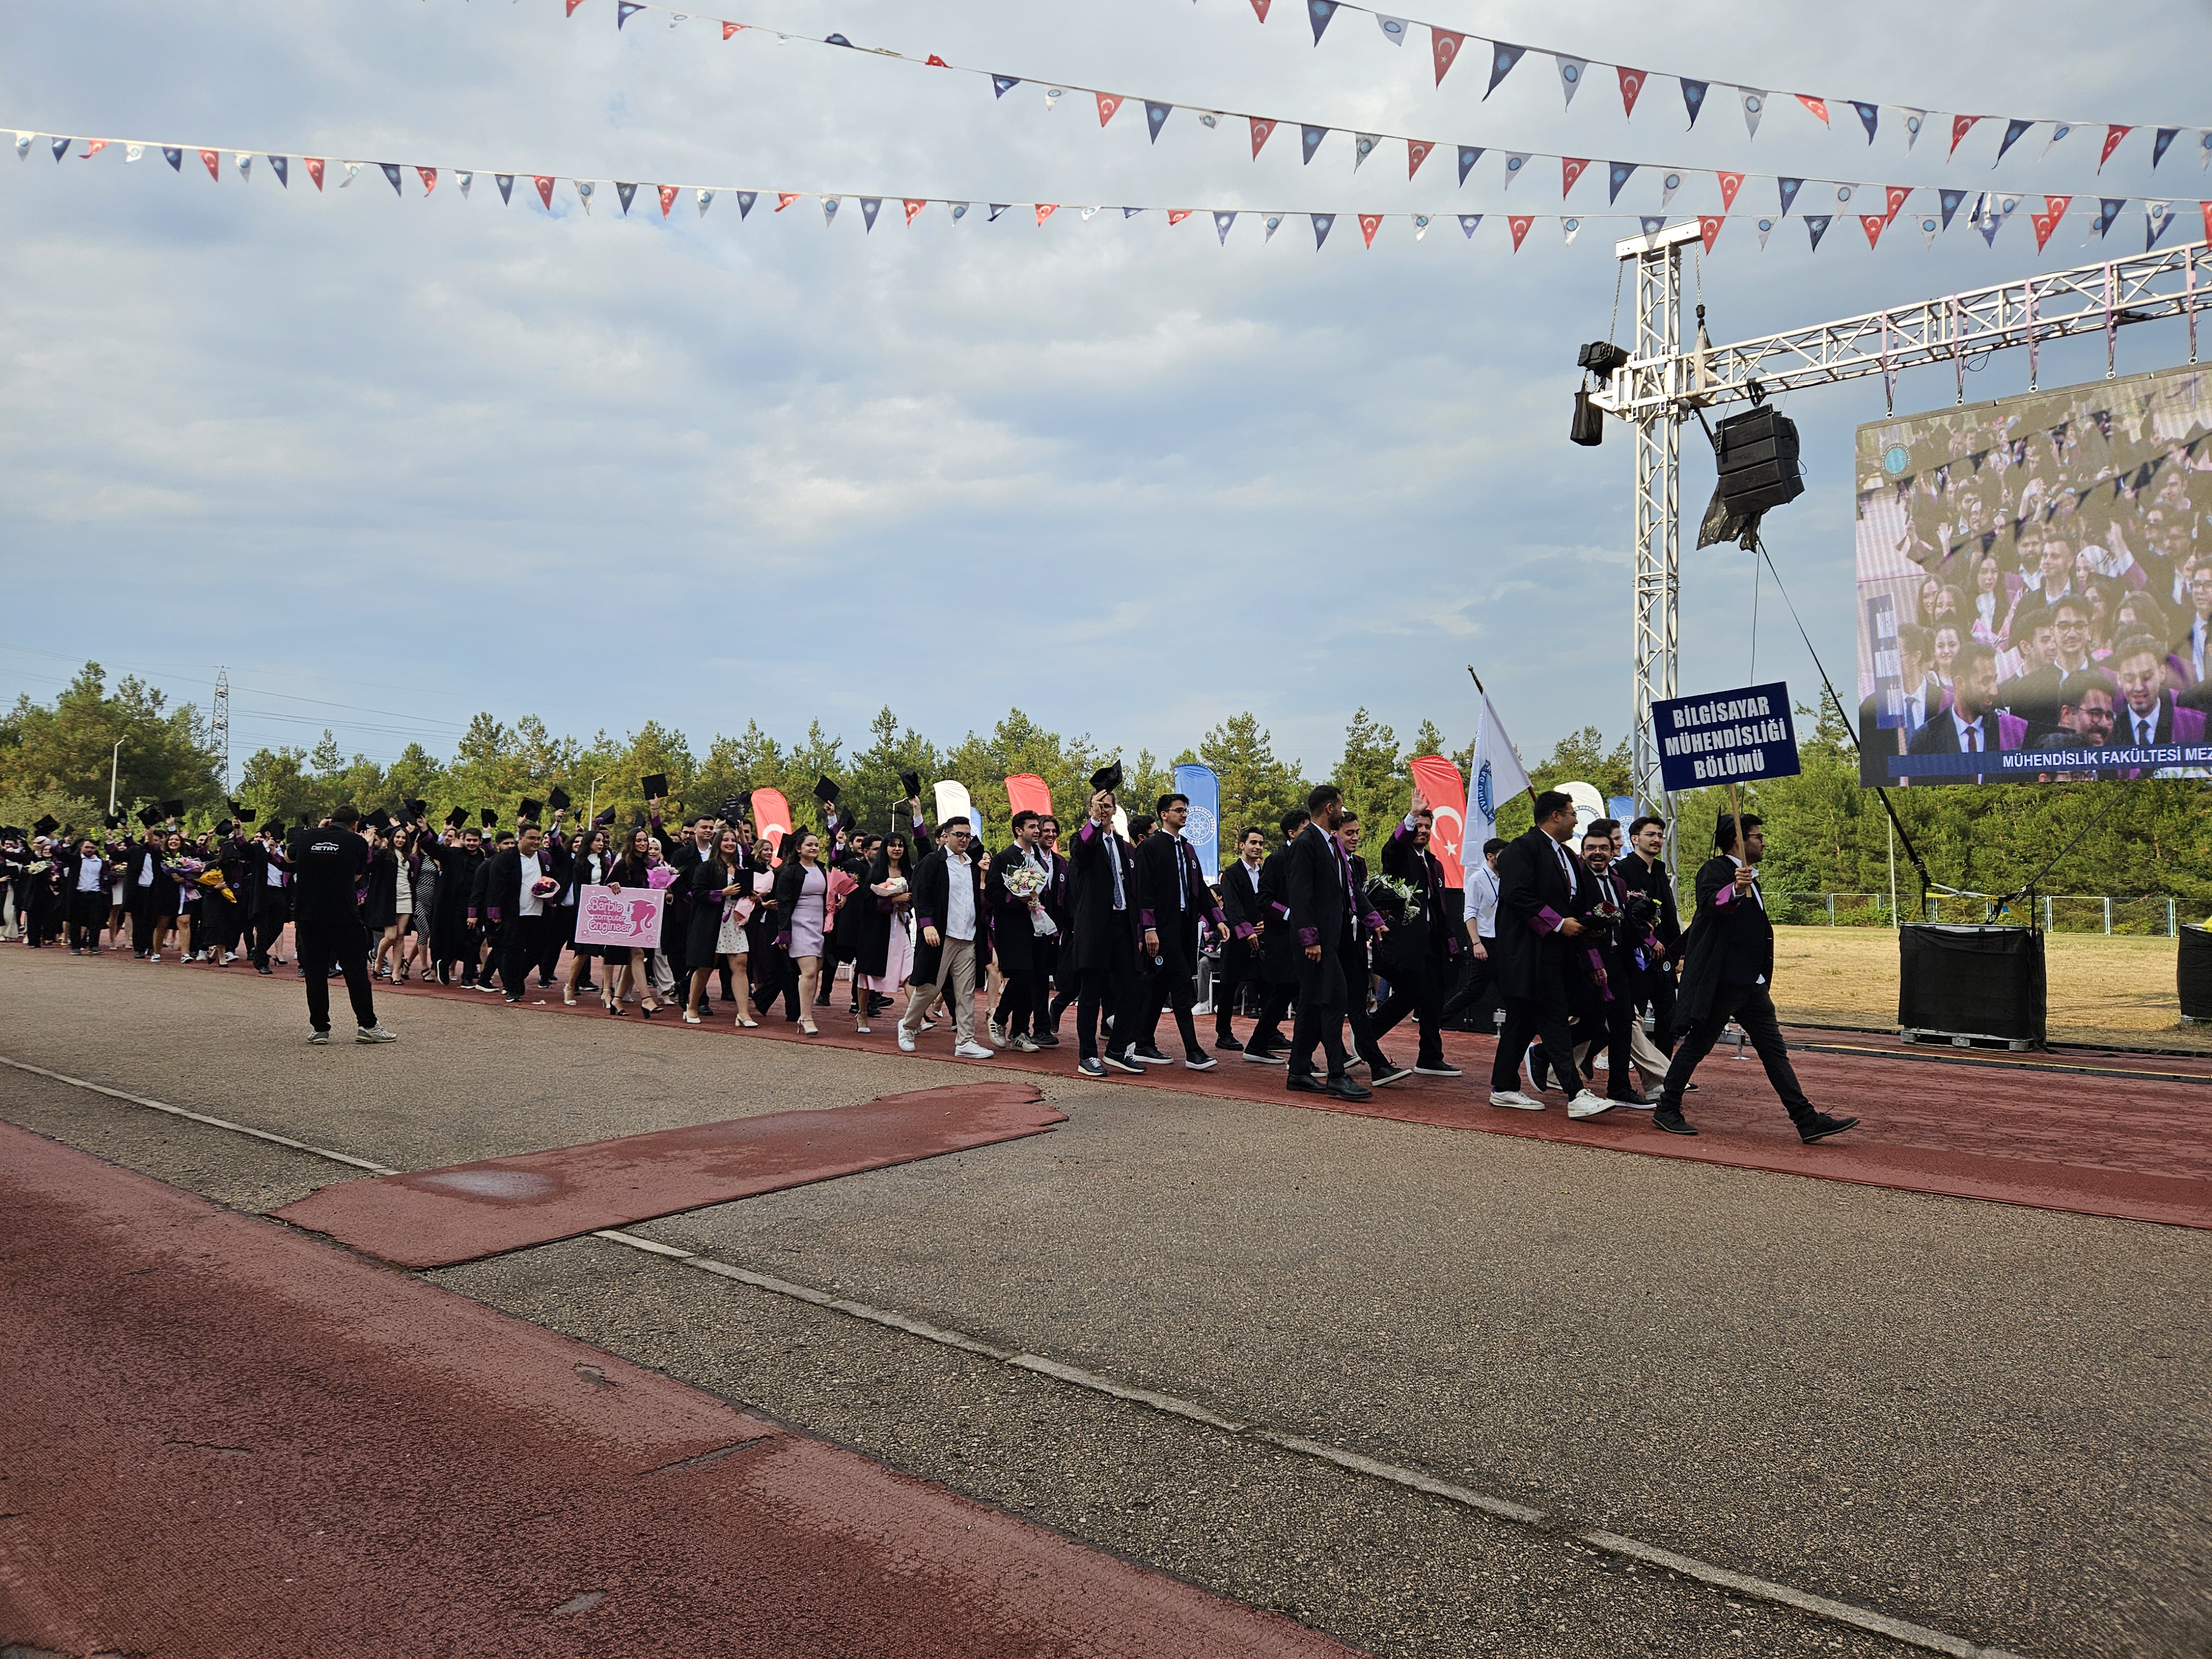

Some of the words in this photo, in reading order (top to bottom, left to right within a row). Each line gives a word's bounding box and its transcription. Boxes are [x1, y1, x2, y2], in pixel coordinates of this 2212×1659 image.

[1672, 696, 1770, 728] BİLGİSAYAR
[1665, 718, 1787, 757] MÜHENDİSLİĞİ
[1693, 749, 1765, 780] BÖLÜMÜ
[2002, 749, 2099, 768] MÜHENDİSLİK
[2102, 746, 2181, 764] FAKÜLTESİ
[587, 898, 623, 912] Barbie
[594, 914, 626, 922] computer
